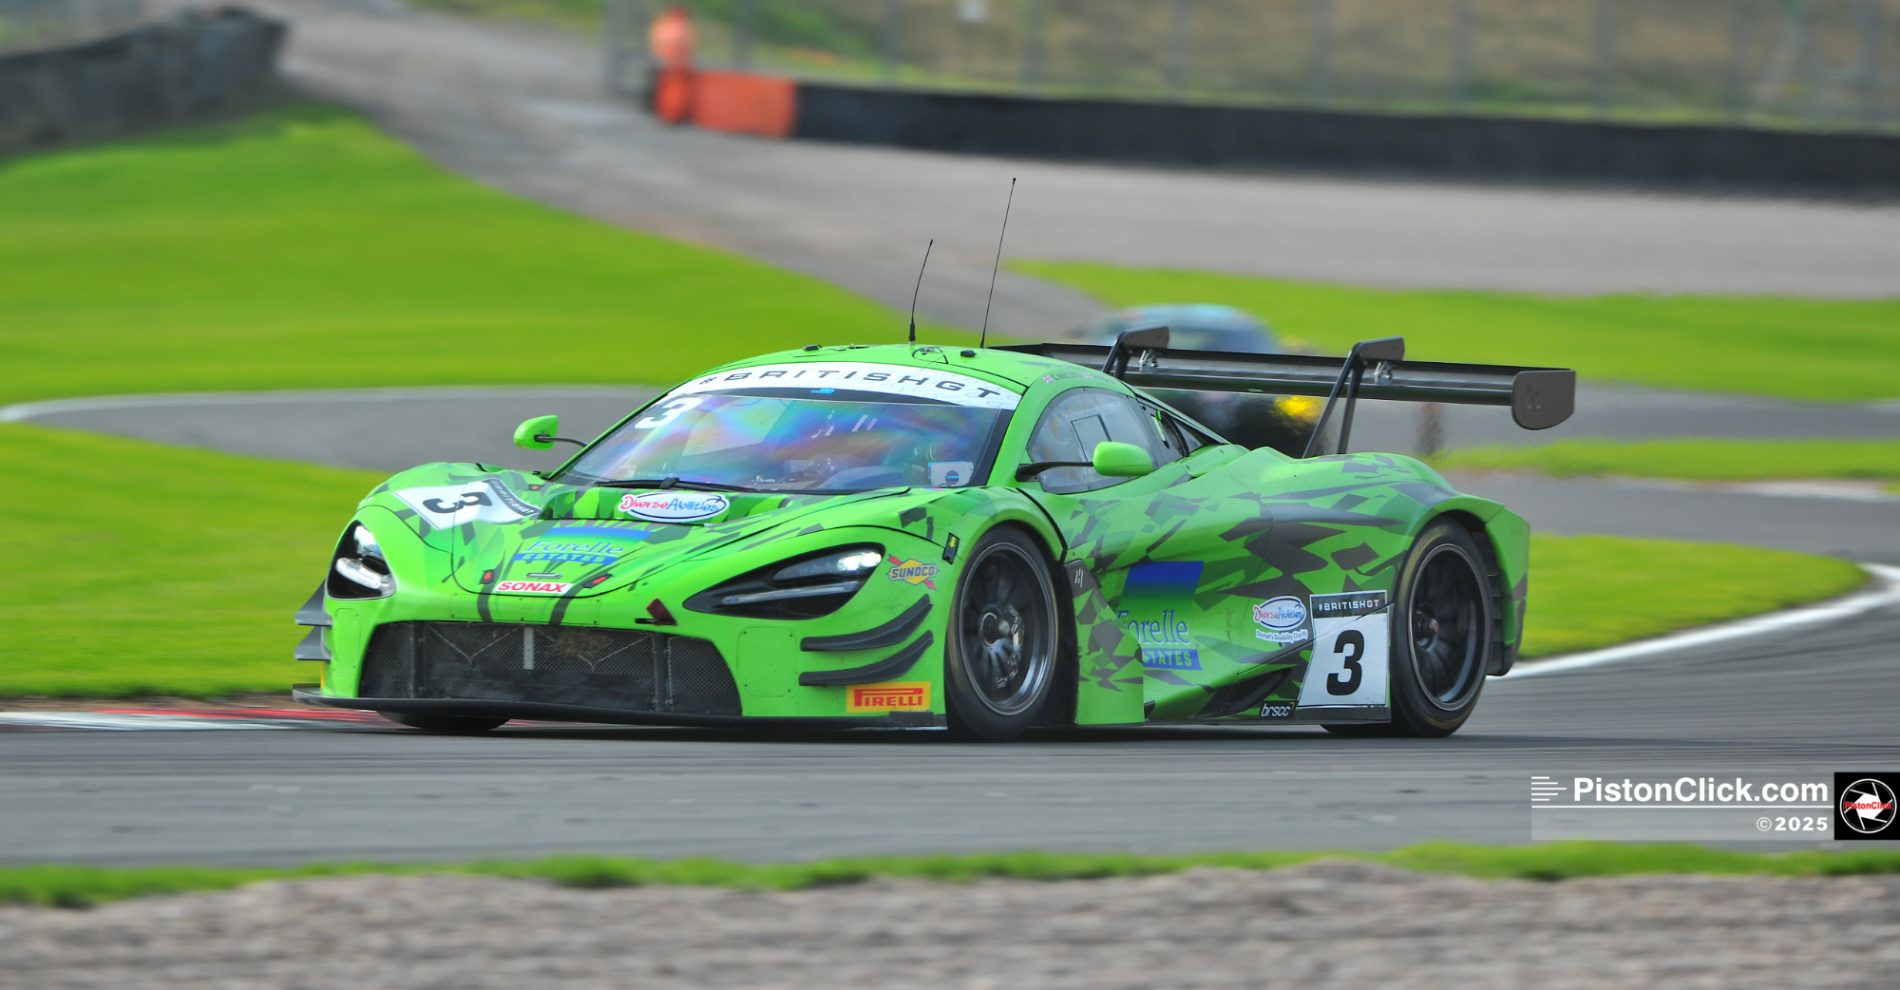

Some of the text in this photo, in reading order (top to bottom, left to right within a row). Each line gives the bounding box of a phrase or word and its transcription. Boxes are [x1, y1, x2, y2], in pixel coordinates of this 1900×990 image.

[699, 370, 1001, 399] #BRITISHGT
[634, 397, 703, 429] 3
[422, 491, 493, 514] 3
[527, 540, 624, 555] Forelle
[891, 566, 936, 579] SUNOCO
[498, 582, 567, 592] SONAX
[1318, 600, 1380, 612] #BRITISHGT
[1142, 650, 1193, 667] STATES
[1326, 629, 1365, 696] 3
[854, 688, 924, 707] PIRELLI
[1261, 703, 1292, 717] brscc
